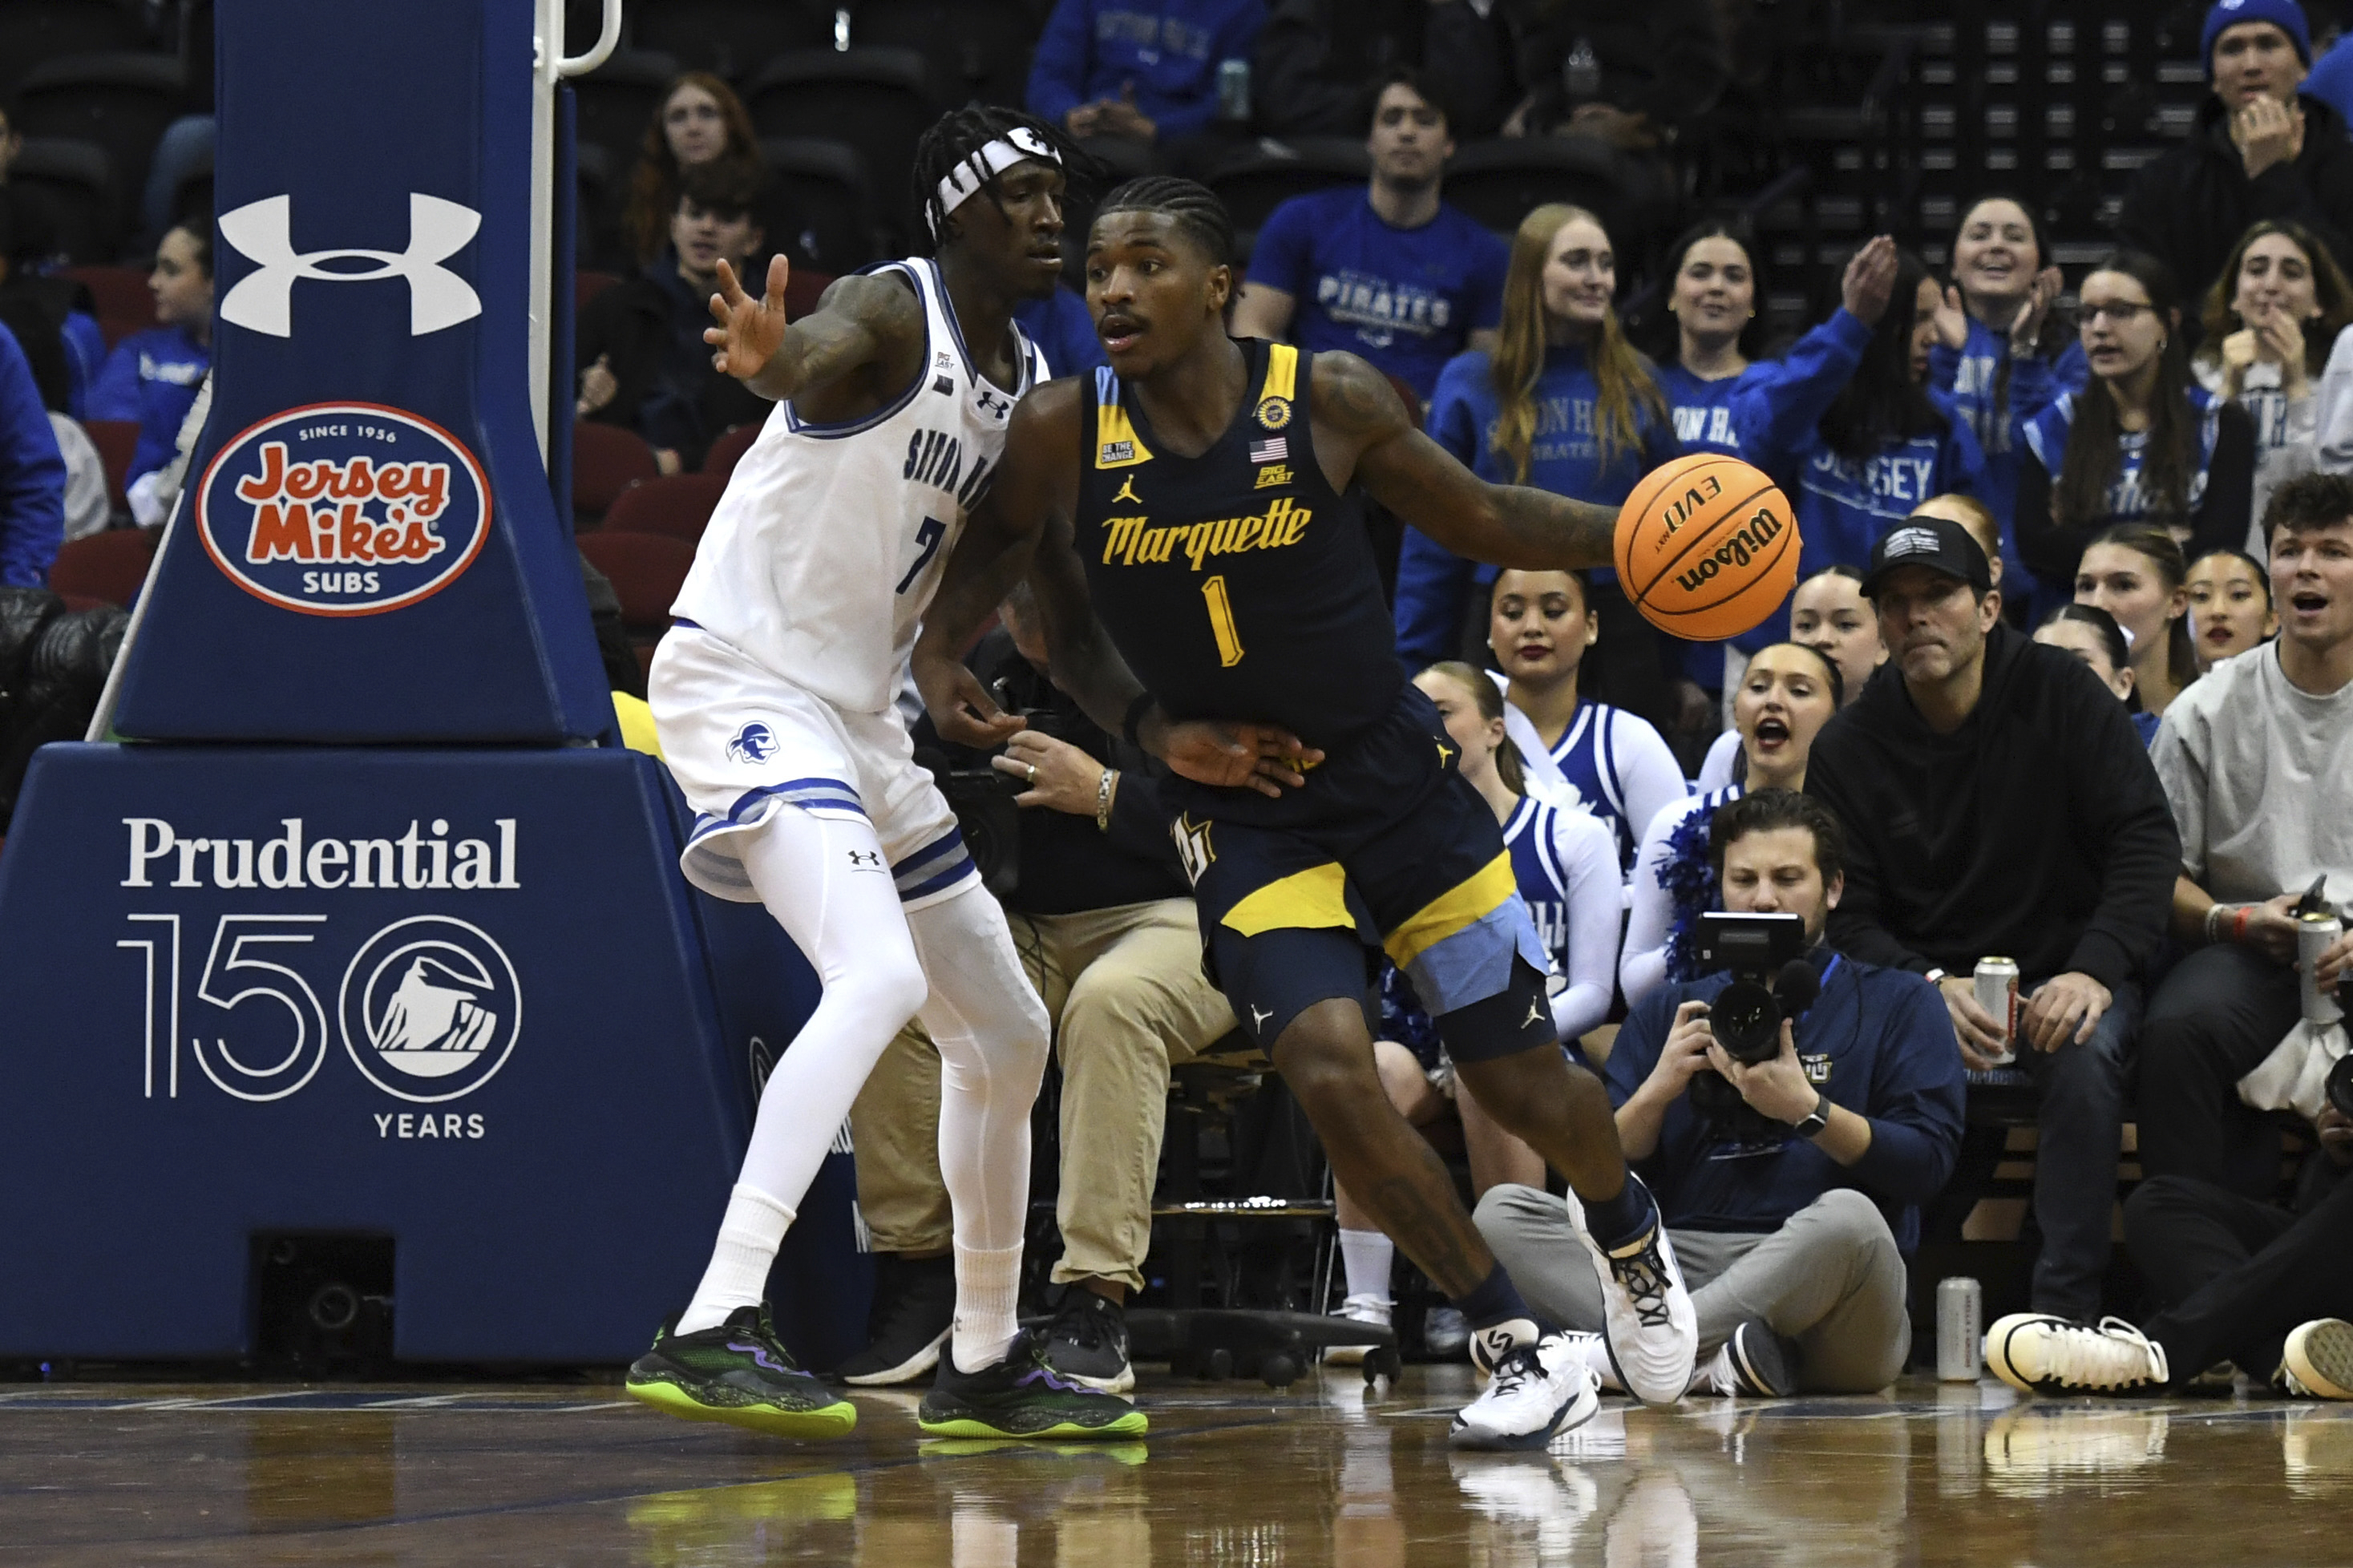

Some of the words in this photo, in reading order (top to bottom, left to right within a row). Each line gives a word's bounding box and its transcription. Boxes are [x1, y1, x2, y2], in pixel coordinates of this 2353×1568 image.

[299, 425, 348, 441] SINCE
[357, 425, 397, 443] 1956
[1102, 450, 1134, 463] CHANGE
[1103, 444, 1113, 454] BE
[1115, 441, 1132, 451] THE
[236, 442, 450, 521] Jersey
[1254, 471, 1295, 487] EAST
[1259, 464, 1287, 476] BIG
[245, 499, 446, 566] Mike's
[1101, 497, 1312, 572] Marquette
[1662, 475, 1723, 535] EVO
[895, 515, 947, 595] 7
[1654, 531, 1672, 555] NXT
[1674, 506, 1784, 593] Wilson
[302, 571, 381, 594] SUBS
[1200, 575, 1245, 669] 1
[119, 818, 522, 890] Prudential
[115, 913, 523, 1103] 150
[374, 1113, 486, 1139] YEARS
